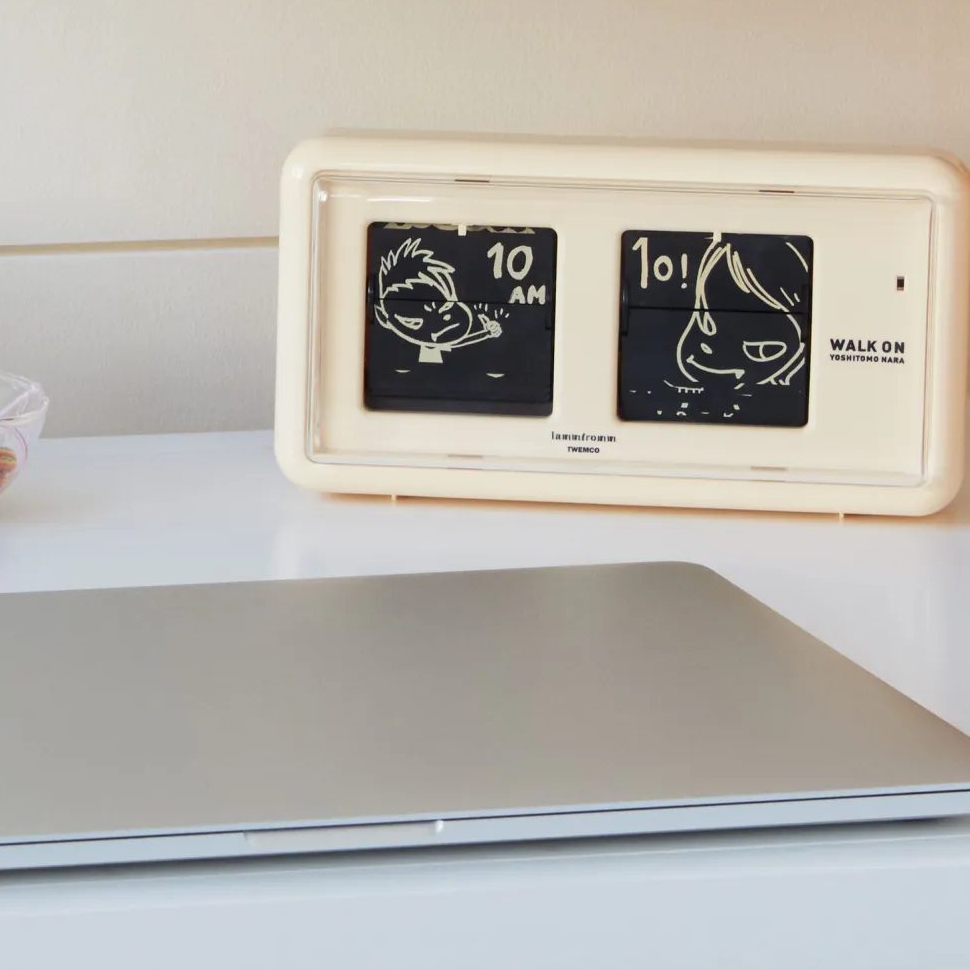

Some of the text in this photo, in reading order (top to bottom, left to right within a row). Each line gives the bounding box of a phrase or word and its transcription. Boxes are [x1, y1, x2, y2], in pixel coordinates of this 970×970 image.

[486, 241, 534, 280] 10
[508, 284, 547, 305] AM
[829, 338, 905, 354] WALK ON
[829, 353, 905, 364] YOSHITOMO NARA
[567, 445, 600, 453] TWEMCO
